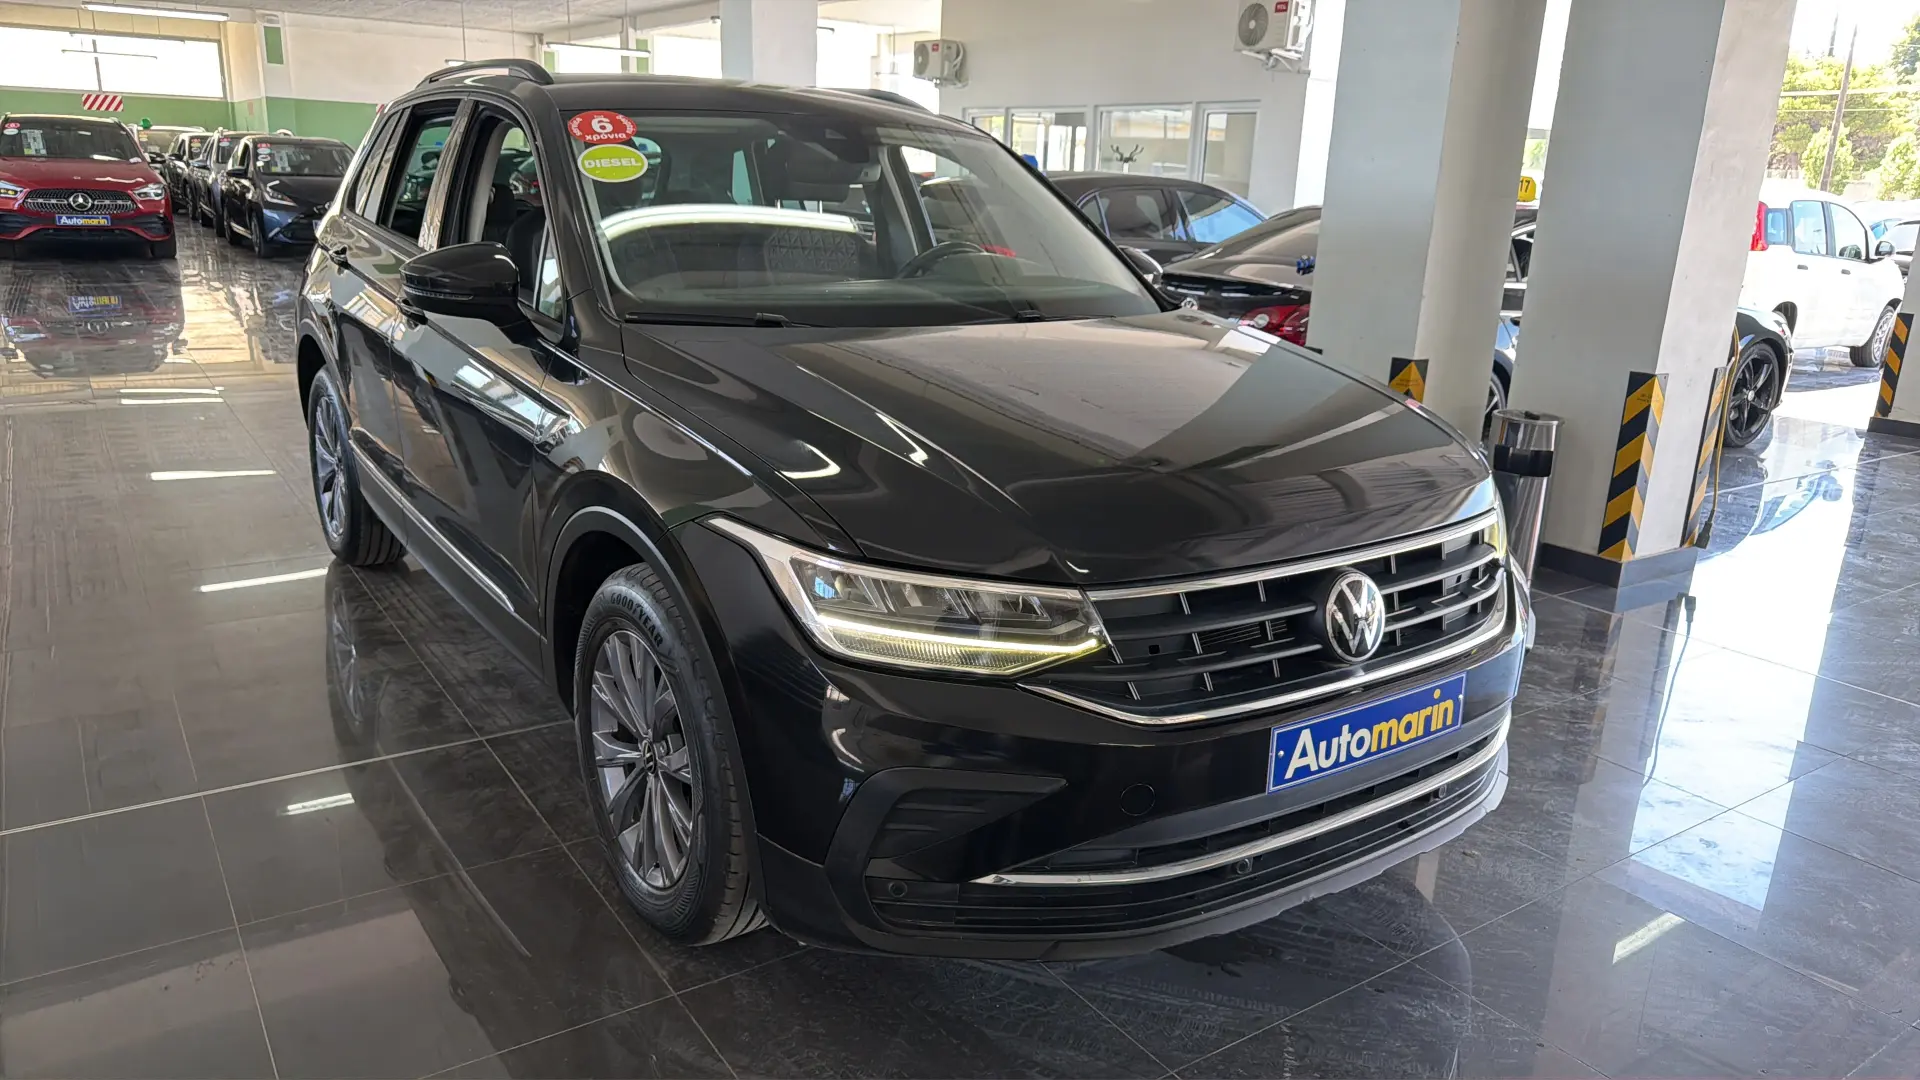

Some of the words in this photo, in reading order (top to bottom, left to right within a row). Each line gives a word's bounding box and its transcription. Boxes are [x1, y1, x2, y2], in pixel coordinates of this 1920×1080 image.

[591, 117, 613, 133] 6
[584, 131, 627, 141] χρόνια
[583, 157, 642, 169] DIESEL
[60, 216, 108, 225] Automarin
[610, 592, 664, 648] GOODYEAR
[1284, 688, 1454, 780] Automarin
